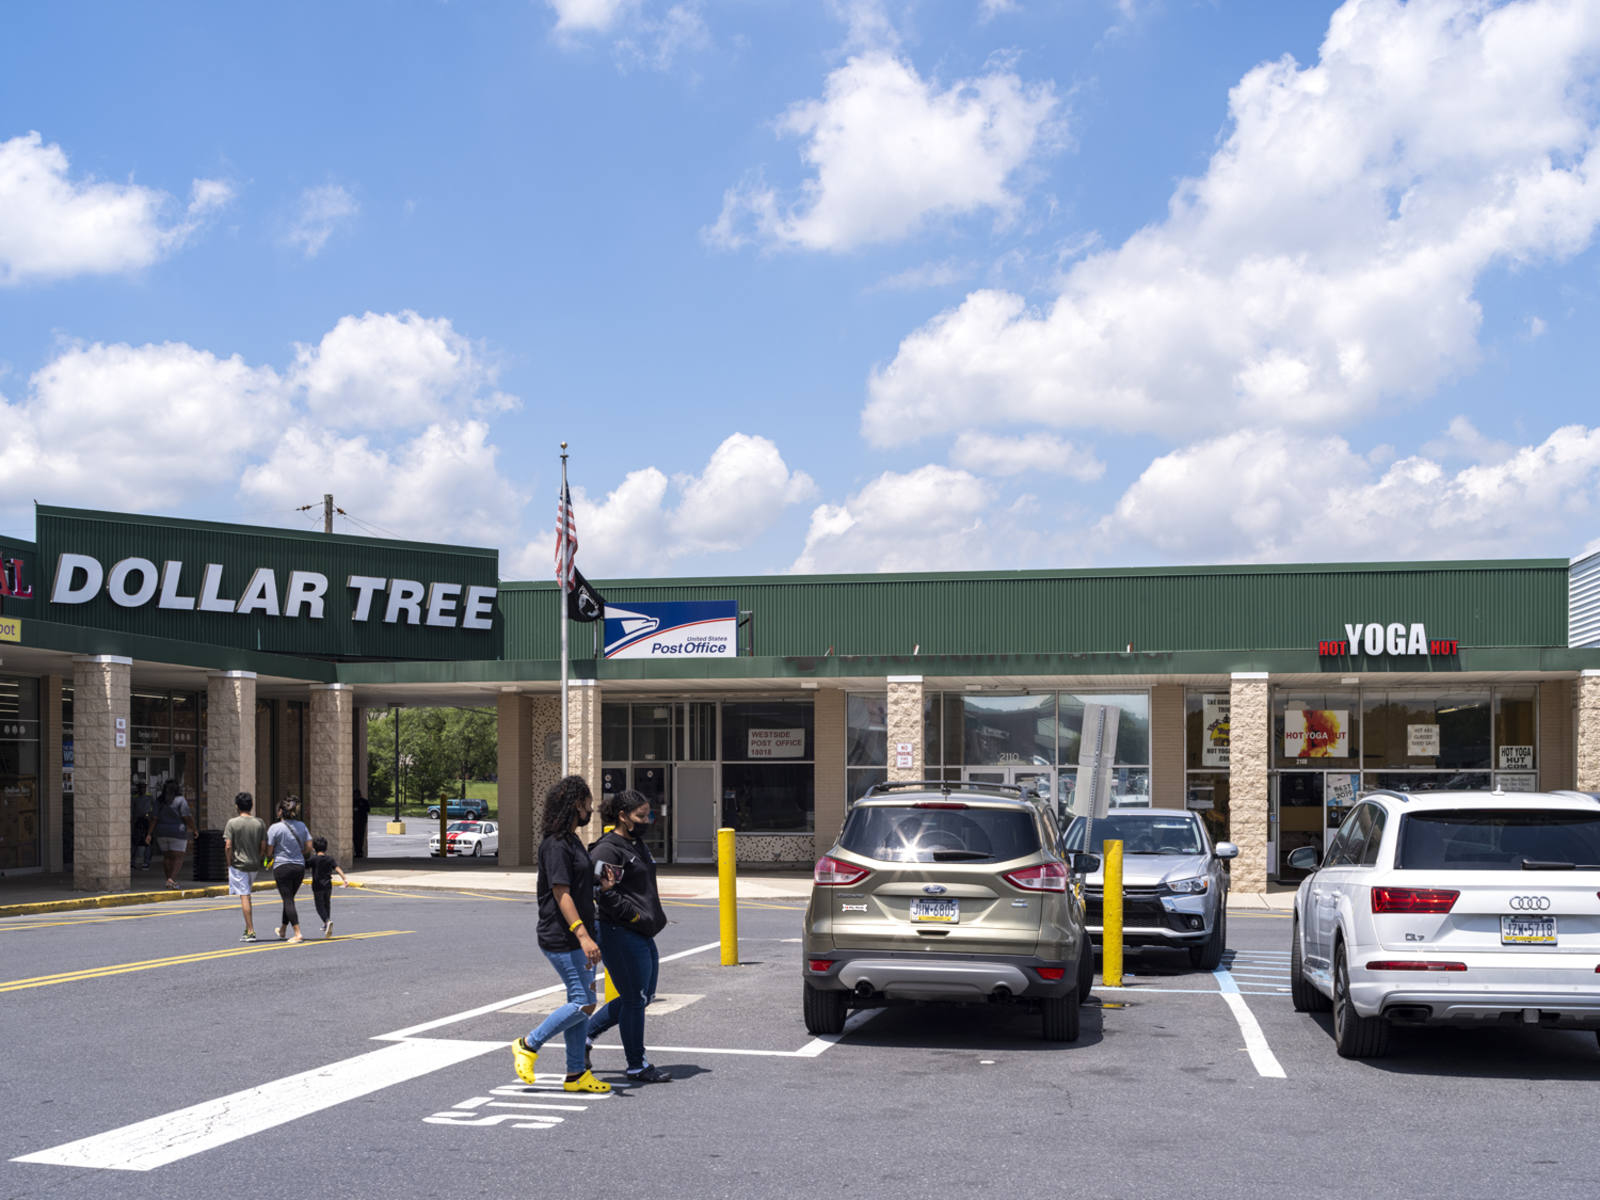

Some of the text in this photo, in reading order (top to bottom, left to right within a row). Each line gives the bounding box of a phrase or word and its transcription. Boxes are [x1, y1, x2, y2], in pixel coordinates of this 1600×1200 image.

[50, 553, 498, 631] DOLLAR TREE
[1319, 622, 1459, 656] HOT YOGA HUT
[1286, 731, 1304, 740] HOT
[1305, 731, 1329, 740] YOGA
[775, 739, 802, 747] OFFICE
[1000, 752, 1020, 761] 2110
[1501, 747, 1532, 757] HOT YOGA
